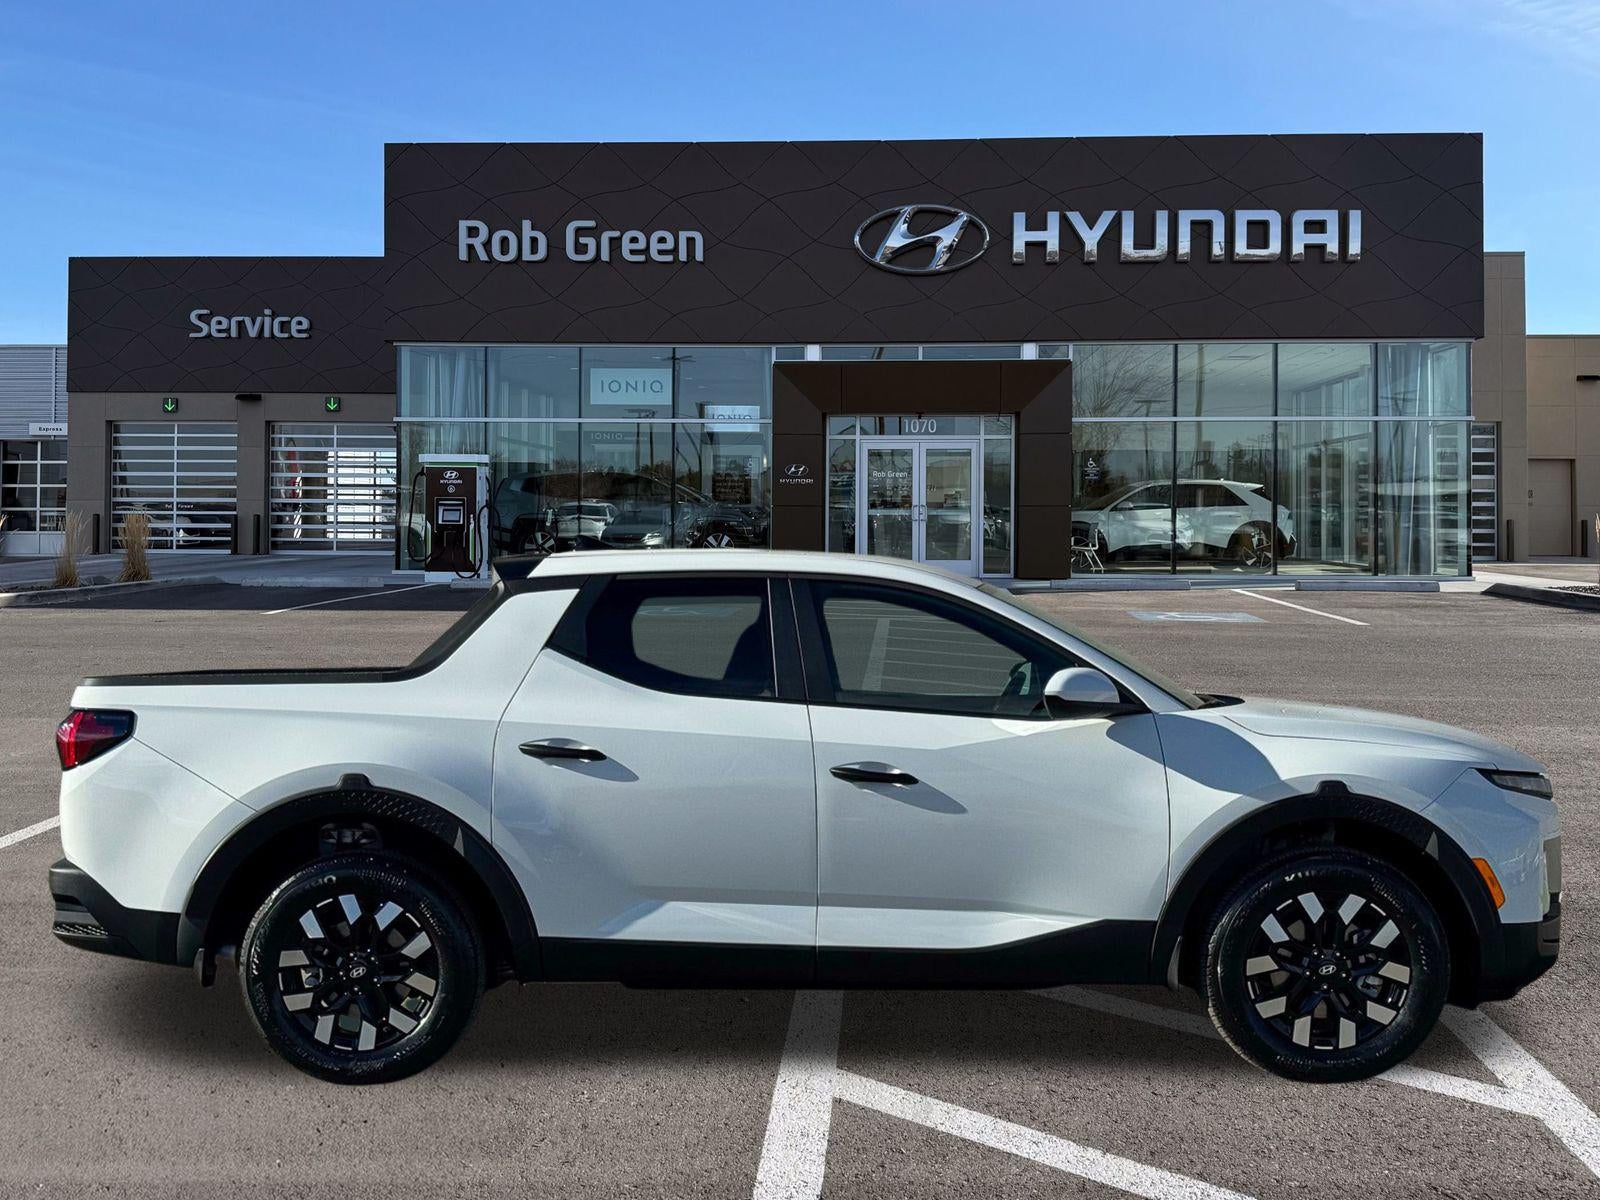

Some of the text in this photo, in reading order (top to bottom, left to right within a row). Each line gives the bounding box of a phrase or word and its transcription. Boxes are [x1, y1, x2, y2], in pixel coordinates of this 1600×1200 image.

[457, 219, 704, 263] Rob Green
[1011, 208, 1362, 264] HYUNDAI
[188, 308, 311, 339] Service
[601, 379, 664, 394] IONIQ
[904, 418, 937, 433] 1070
[591, 432, 624, 441] IONIQ
[872, 470, 908, 478] Rob Green
